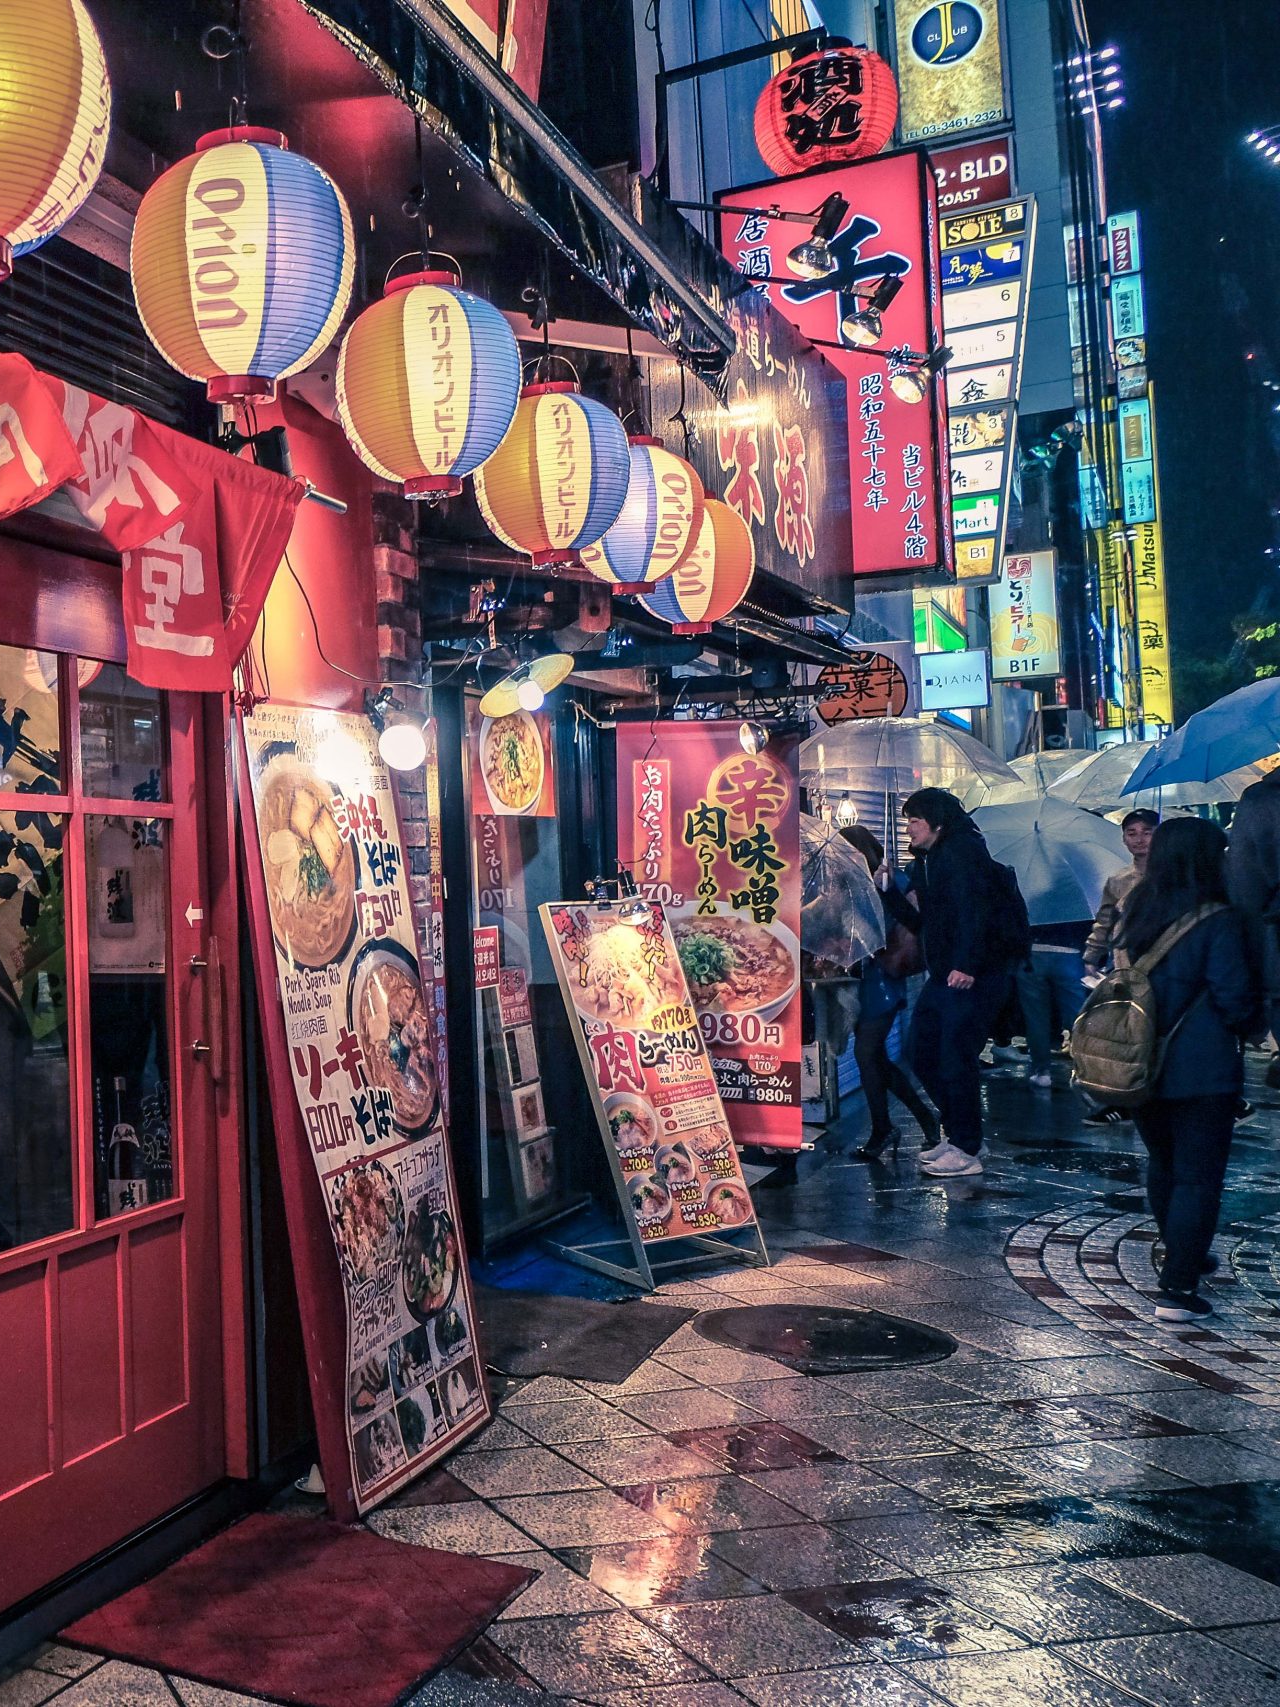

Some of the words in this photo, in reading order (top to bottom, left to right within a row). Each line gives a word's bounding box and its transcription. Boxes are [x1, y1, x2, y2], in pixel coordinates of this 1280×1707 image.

[905, 130, 920, 139] TEL
[922, 109, 1003, 136] 03-3461-2321
[1010, 208, 1019, 218] 8
[1111, 219, 1118, 227] 8
[1008, 250, 1015, 260] 7
[1115, 229, 1129, 270] カラオケ
[1001, 289, 1011, 300] 6
[996, 330, 1006, 342] 5
[427, 303, 459, 468] オリオンビール
[997, 369, 1005, 378] 4
[988, 417, 998, 429] 3
[860, 372, 888, 512] 昭和五十七年
[552, 403, 575, 539] オリオンビール
[984, 459, 993, 471] 2
[1125, 466, 1132, 474] 4
[901, 445, 927, 558] 当ビル4階
[970, 547, 987, 559] B1
[1010, 580, 1025, 634] とりビアー
[1010, 658, 1041, 673] B1F
[641, 764, 664, 881] お肉たっぷり
[364, 841, 402, 888] そば
[684, 801, 728, 915] 肉らーめん
[285, 974, 303, 995] Pork
[305, 972, 327, 993] Spare
[328, 966, 341, 987] Rib
[287, 994, 312, 1016] Noodle
[313, 991, 332, 1010] Soup
[291, 1015, 329, 1040] 红烧肉面
[699, 1012, 781, 1044] 980円
[590, 1021, 646, 1091] 肉
[638, 1030, 697, 1061] らーめん
[666, 1054, 703, 1073] 750円
[754, 1062, 777, 1073] 170g
[756, 1087, 793, 1103] 980円
[305, 1102, 357, 1154] 800円
[349, 1086, 395, 1146] そば
